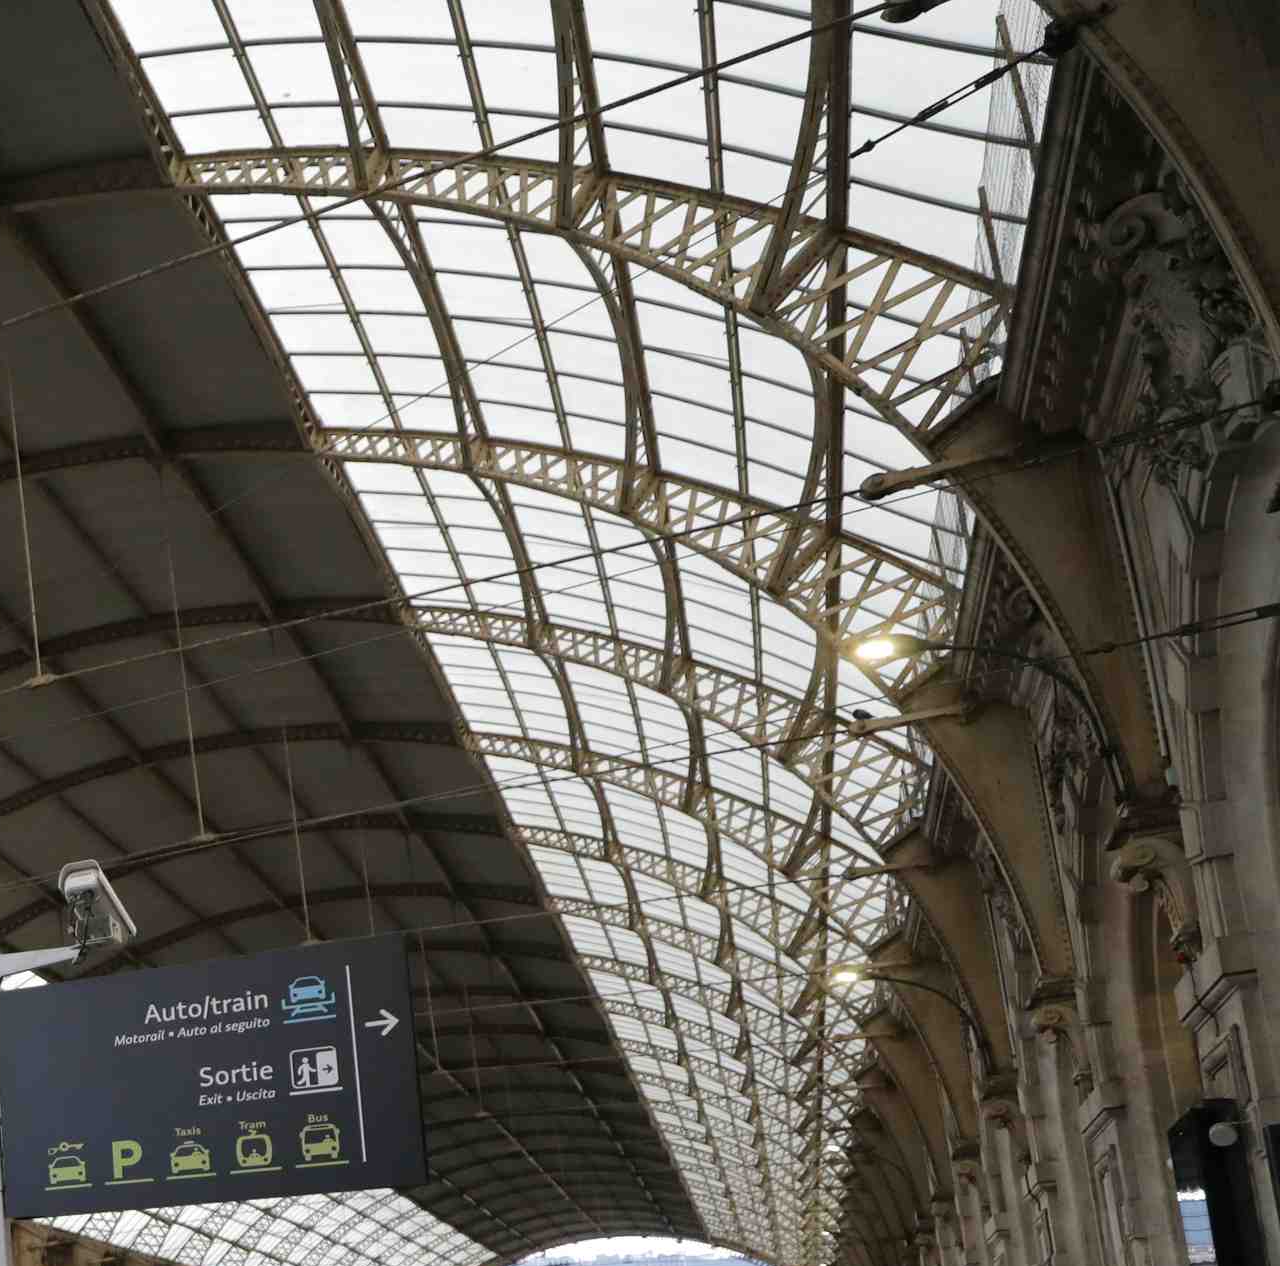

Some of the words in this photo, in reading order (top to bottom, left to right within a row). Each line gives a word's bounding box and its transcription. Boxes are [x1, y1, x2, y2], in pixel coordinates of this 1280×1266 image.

[144, 990, 268, 1024] Auto/train
[114, 1029, 165, 1047] Motorail
[177, 1026, 207, 1038] Auto
[210, 1022, 222, 1034] al
[225, 1017, 270, 1033] seguito
[199, 1061, 273, 1087] Sortie
[199, 1094, 222, 1106] Exit
[236, 1088, 276, 1102] Uscita
[238, 1120, 266, 1131] Tram
[307, 1114, 329, 1123] Bus
[175, 1126, 201, 1137] Taxis
[112, 1140, 143, 1178] P
